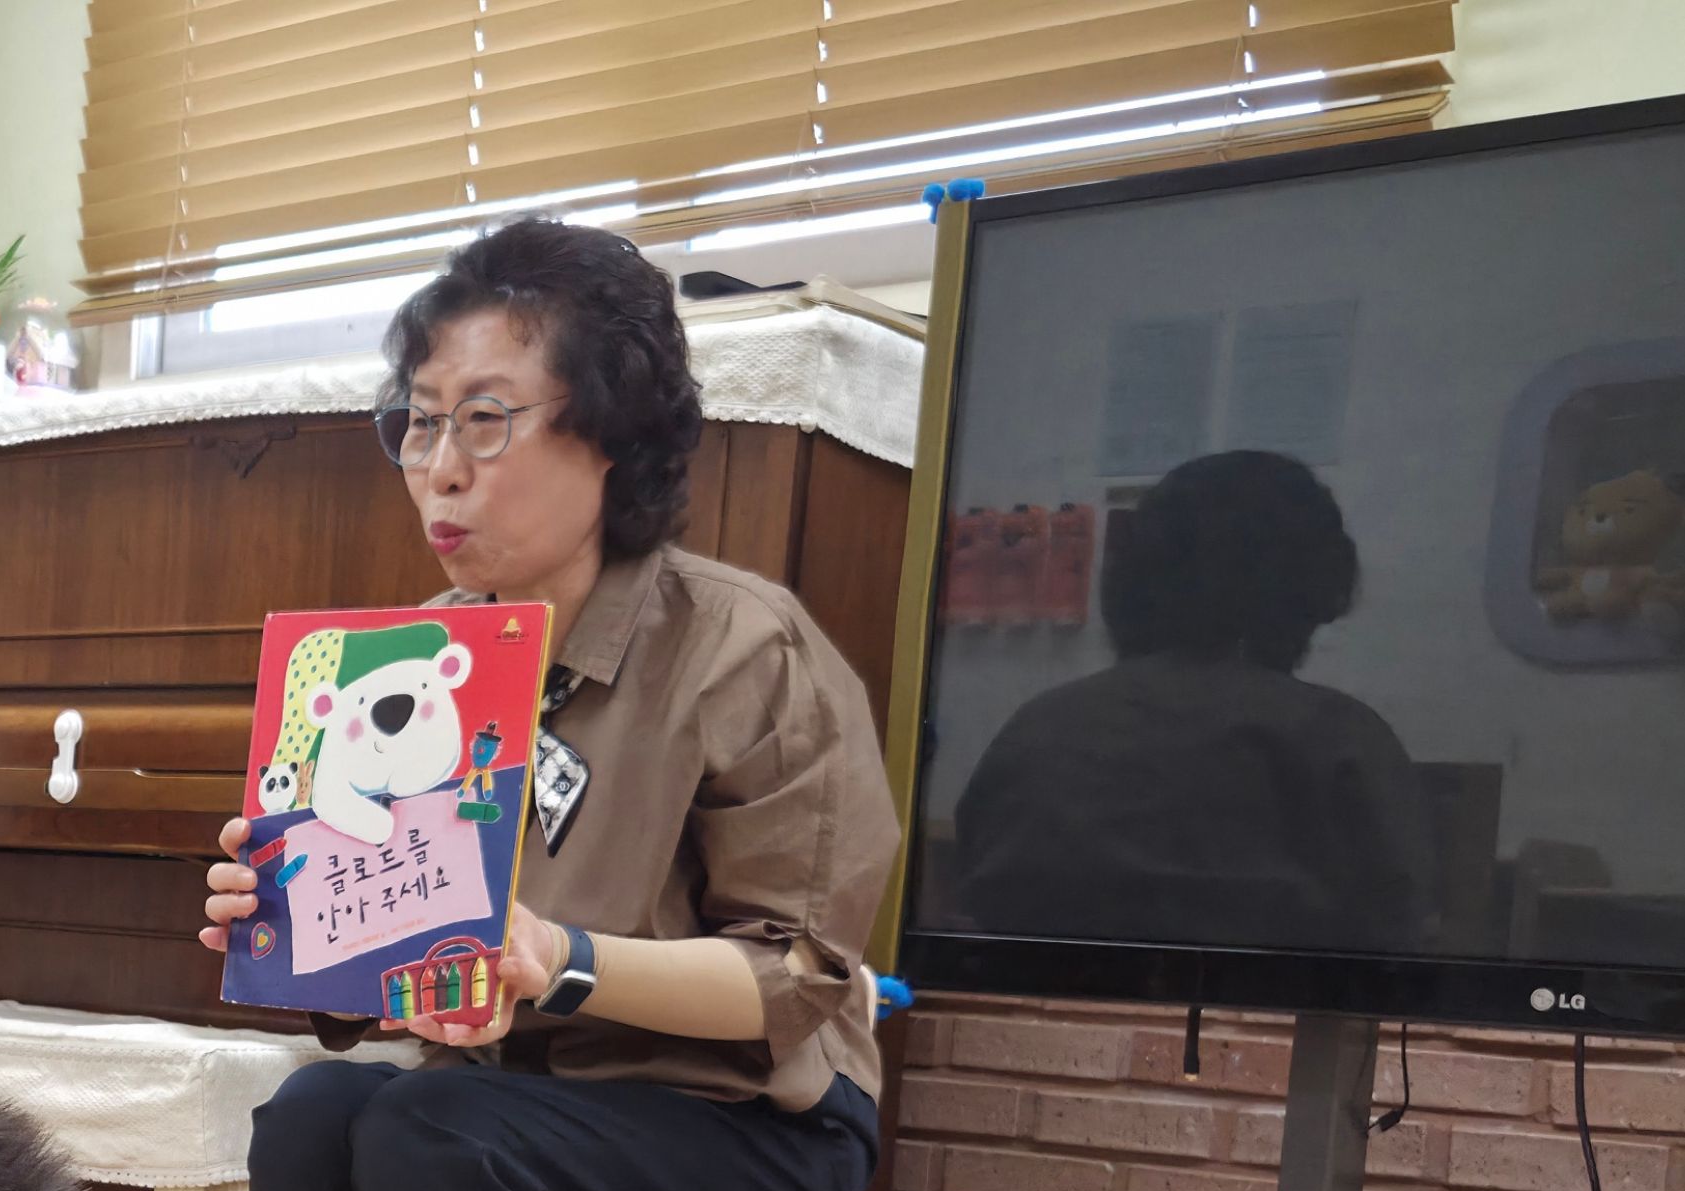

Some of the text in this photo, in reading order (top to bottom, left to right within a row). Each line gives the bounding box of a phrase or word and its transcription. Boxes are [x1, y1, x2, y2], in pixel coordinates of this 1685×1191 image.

[323, 828, 430, 896] 클로드를
[317, 896, 370, 944] 안아
[380, 866, 451, 913] 주세요
[1558, 993, 1586, 1011] LG
